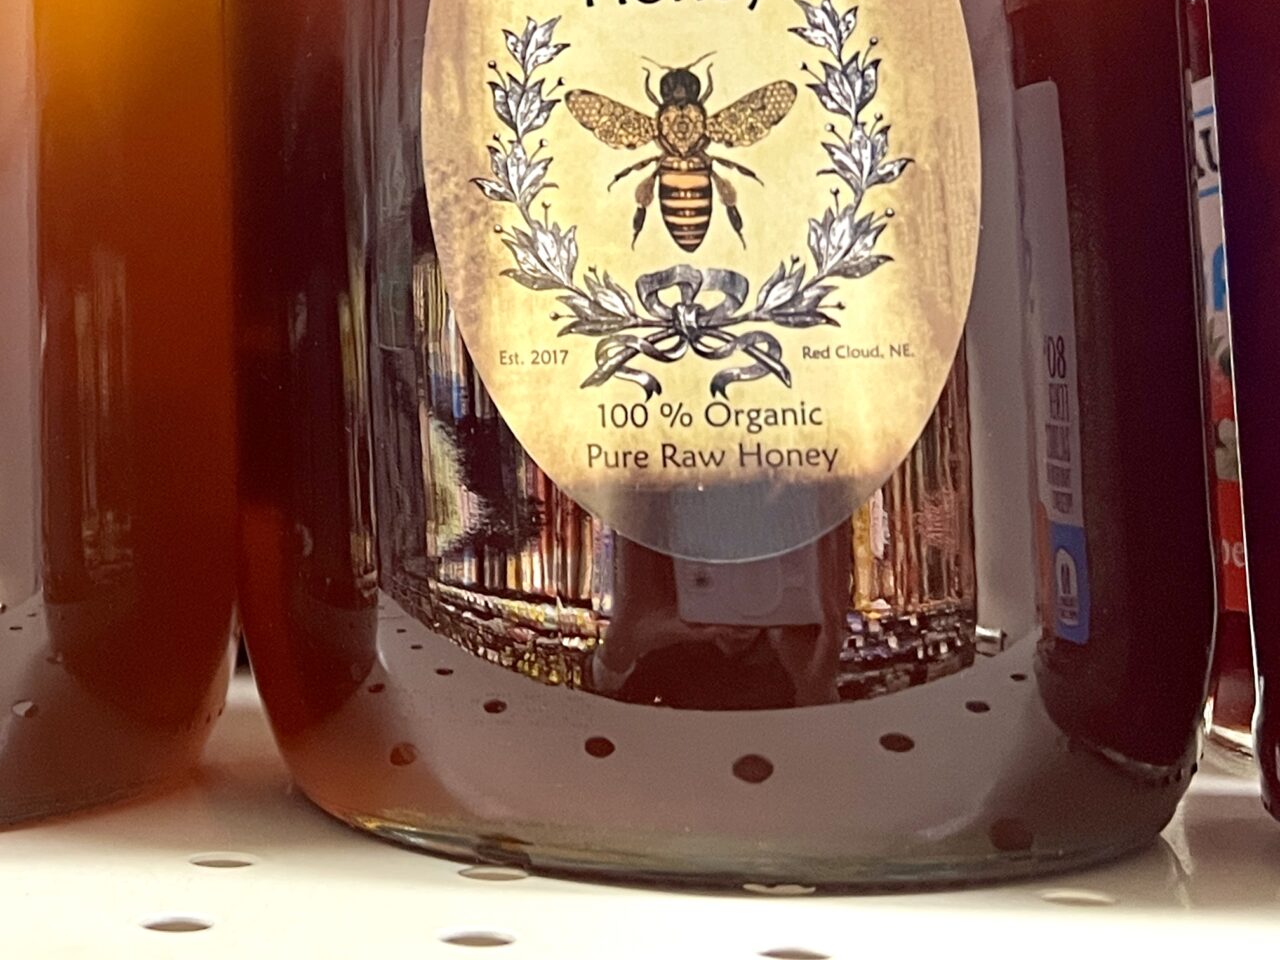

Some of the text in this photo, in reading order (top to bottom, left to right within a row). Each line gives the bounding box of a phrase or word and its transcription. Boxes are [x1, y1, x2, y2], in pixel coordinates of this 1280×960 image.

[499, 348, 569, 367] Est. 2017
[802, 345, 831, 359] Red
[835, 344, 884, 361] Cloud,
[597, 400, 822, 433] 100 % Organic
[587, 442, 838, 473] Pure Raw Honey
